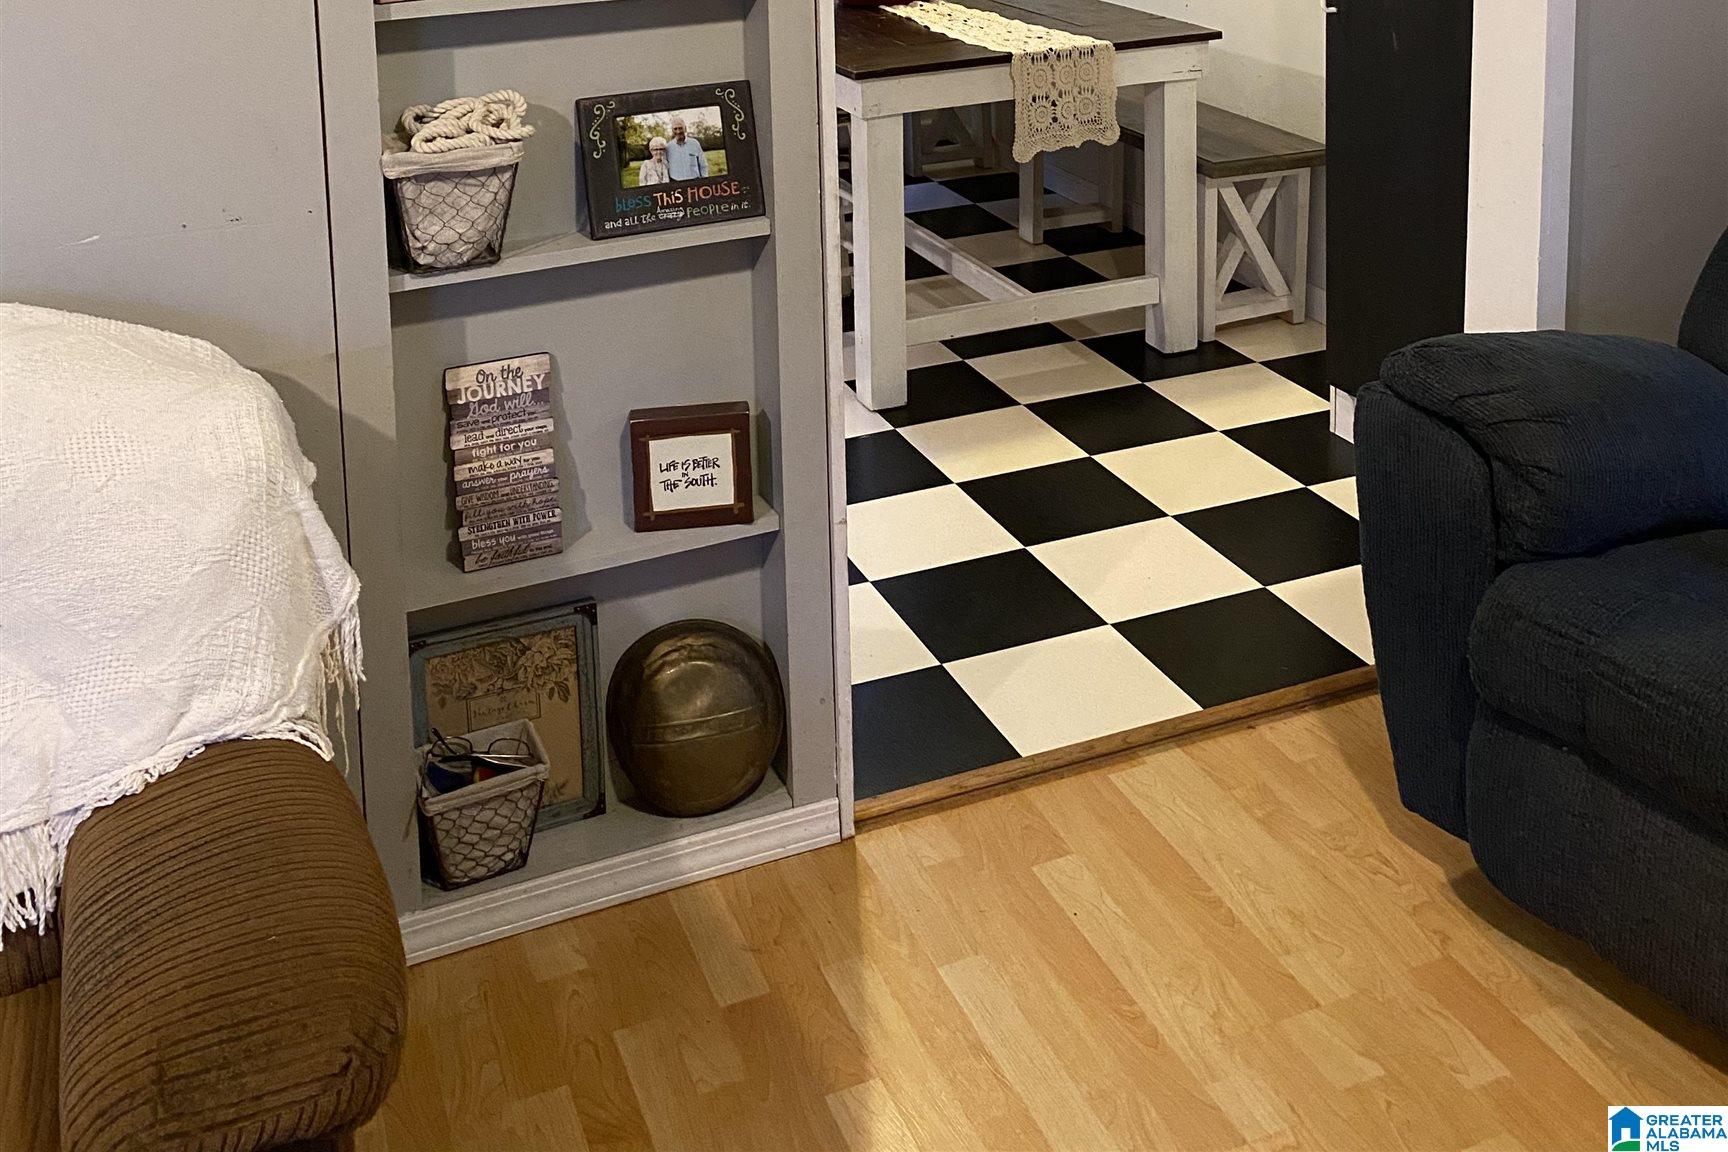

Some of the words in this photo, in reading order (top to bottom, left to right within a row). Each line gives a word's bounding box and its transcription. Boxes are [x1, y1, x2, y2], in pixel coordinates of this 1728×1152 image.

[604, 218, 622, 229] and
[731, 202, 739, 210] in
[476, 369, 497, 384] On
[500, 364, 524, 380] the
[457, 374, 545, 405] JOURNEY
[467, 398, 501, 419] God
[456, 418, 480, 429] save
[491, 409, 527, 424] protect
[464, 431, 484, 443] lead
[495, 424, 524, 437] direct
[472, 446, 497, 458] fight
[500, 443, 517, 452] for
[518, 438, 537, 448] you
[468, 460, 495, 474] make
[496, 460, 503, 468] a
[659, 459, 680, 473] LIFE
[681, 459, 691, 471] IS
[692, 456, 720, 471] BETTER
[462, 477, 497, 489] answer
[509, 466, 550, 483] prayers
[659, 478, 682, 493] THE
[684, 473, 718, 489] SOUTH.
[512, 514, 531, 526] WITH
[532, 510, 557, 522] POWER
[471, 538, 497, 550] bless
[499, 534, 516, 546] you
